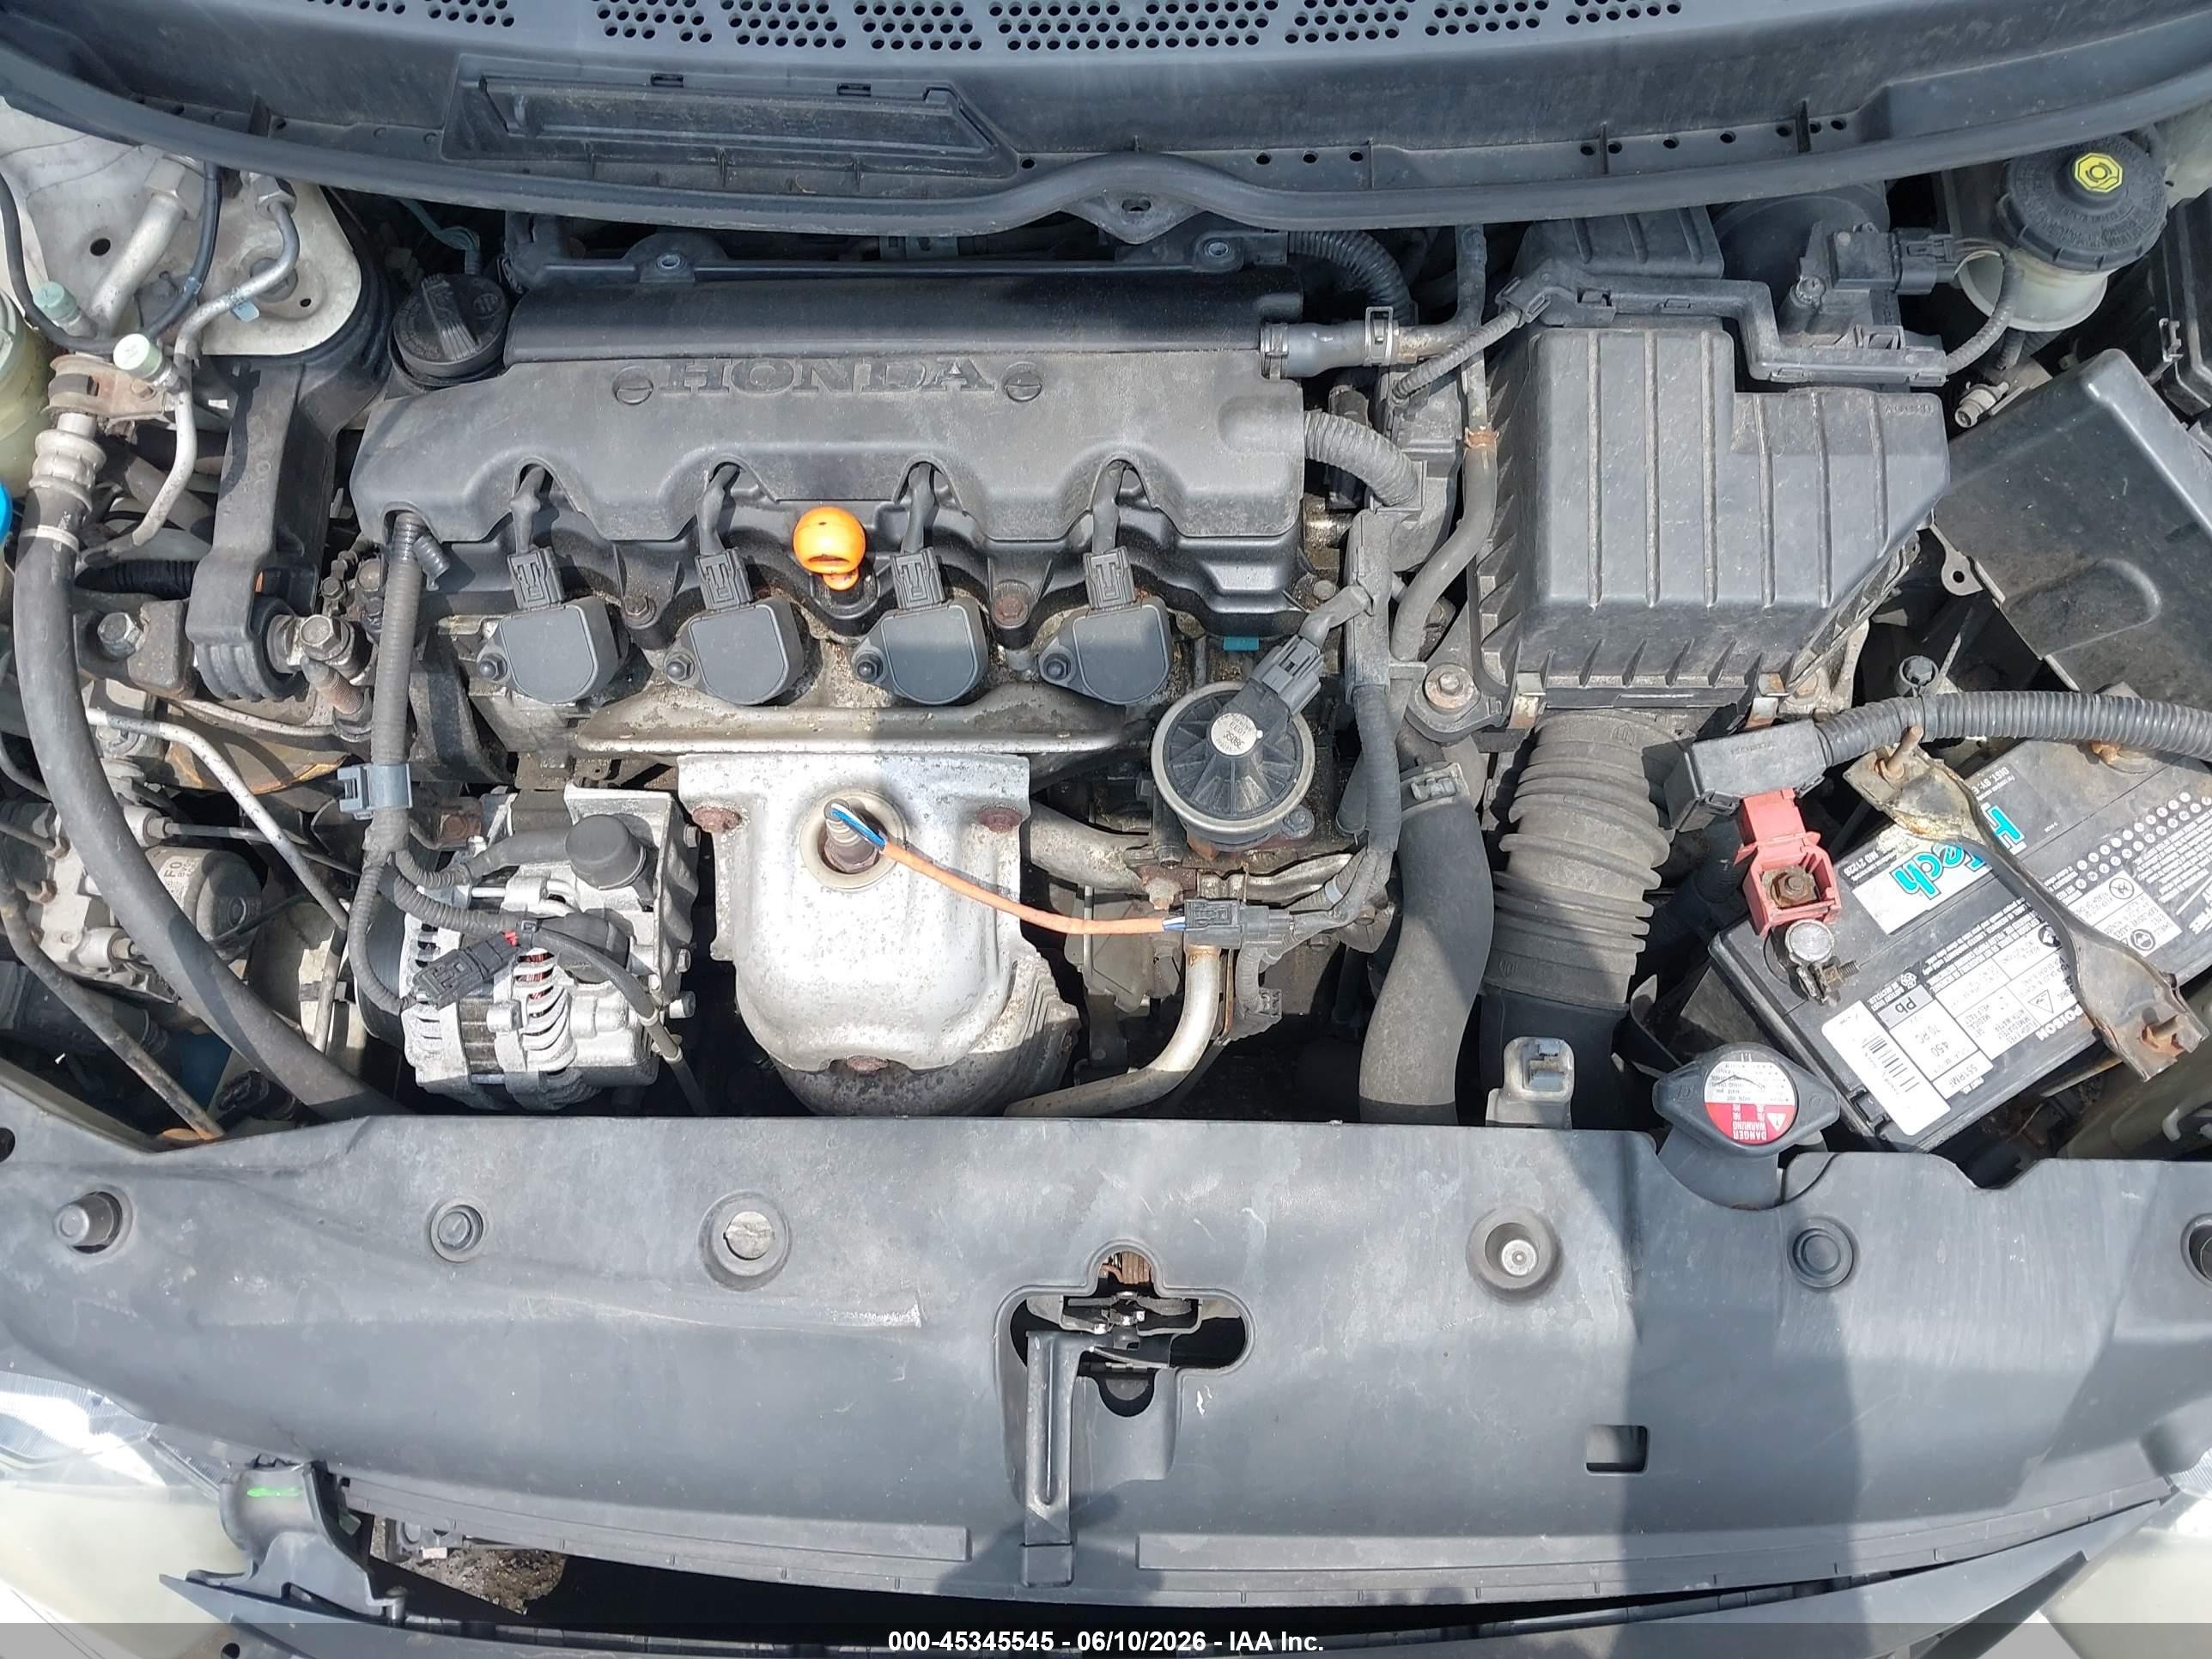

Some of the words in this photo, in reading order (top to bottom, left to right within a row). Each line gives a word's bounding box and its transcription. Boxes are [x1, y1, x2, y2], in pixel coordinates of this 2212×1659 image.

[660, 357, 996, 397] HONDA
[1988, 766, 2008, 782] DIST.
[1977, 778, 1991, 791] BY:
[1893, 996, 1916, 1016] Pb
[2034, 1003, 2083, 1042] POISON
[1929, 1040, 1949, 1056] 450
[1732, 1131, 1766, 1139] DANGER
